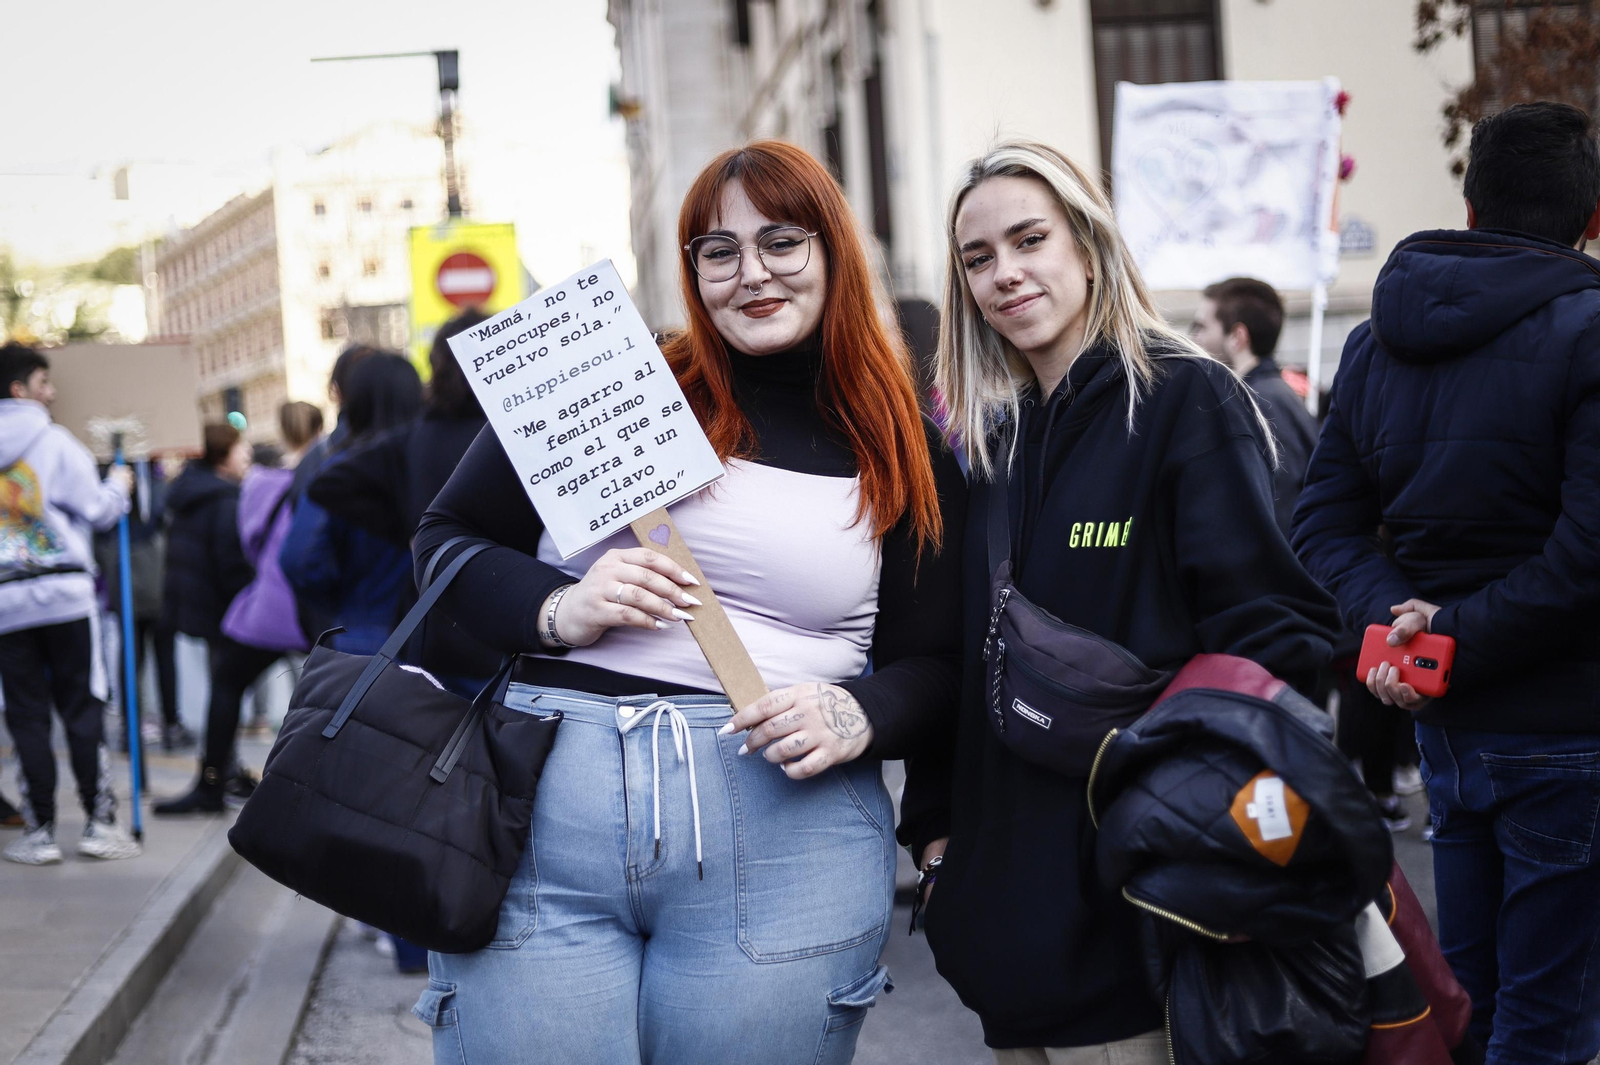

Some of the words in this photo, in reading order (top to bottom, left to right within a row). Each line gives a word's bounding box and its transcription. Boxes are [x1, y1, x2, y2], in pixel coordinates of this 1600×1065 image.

[544, 290, 567, 309] no
[576, 274, 599, 291] te
[472, 311, 580, 372] preocupes,
[592, 290, 615, 308] no
[482, 346, 549, 386] vuelvo
[557, 380, 623, 421] agarro
[634, 361, 656, 382] al
[530, 456, 574, 485] como
[583, 437, 607, 457] el
[616, 416, 651, 442] que
[661, 400, 683, 418] se
[546, 394, 645, 452] feminismo
[556, 456, 623, 497] agarra
[633, 445, 645, 457] a
[653, 428, 678, 446] un
[600, 464, 655, 499] clavo
